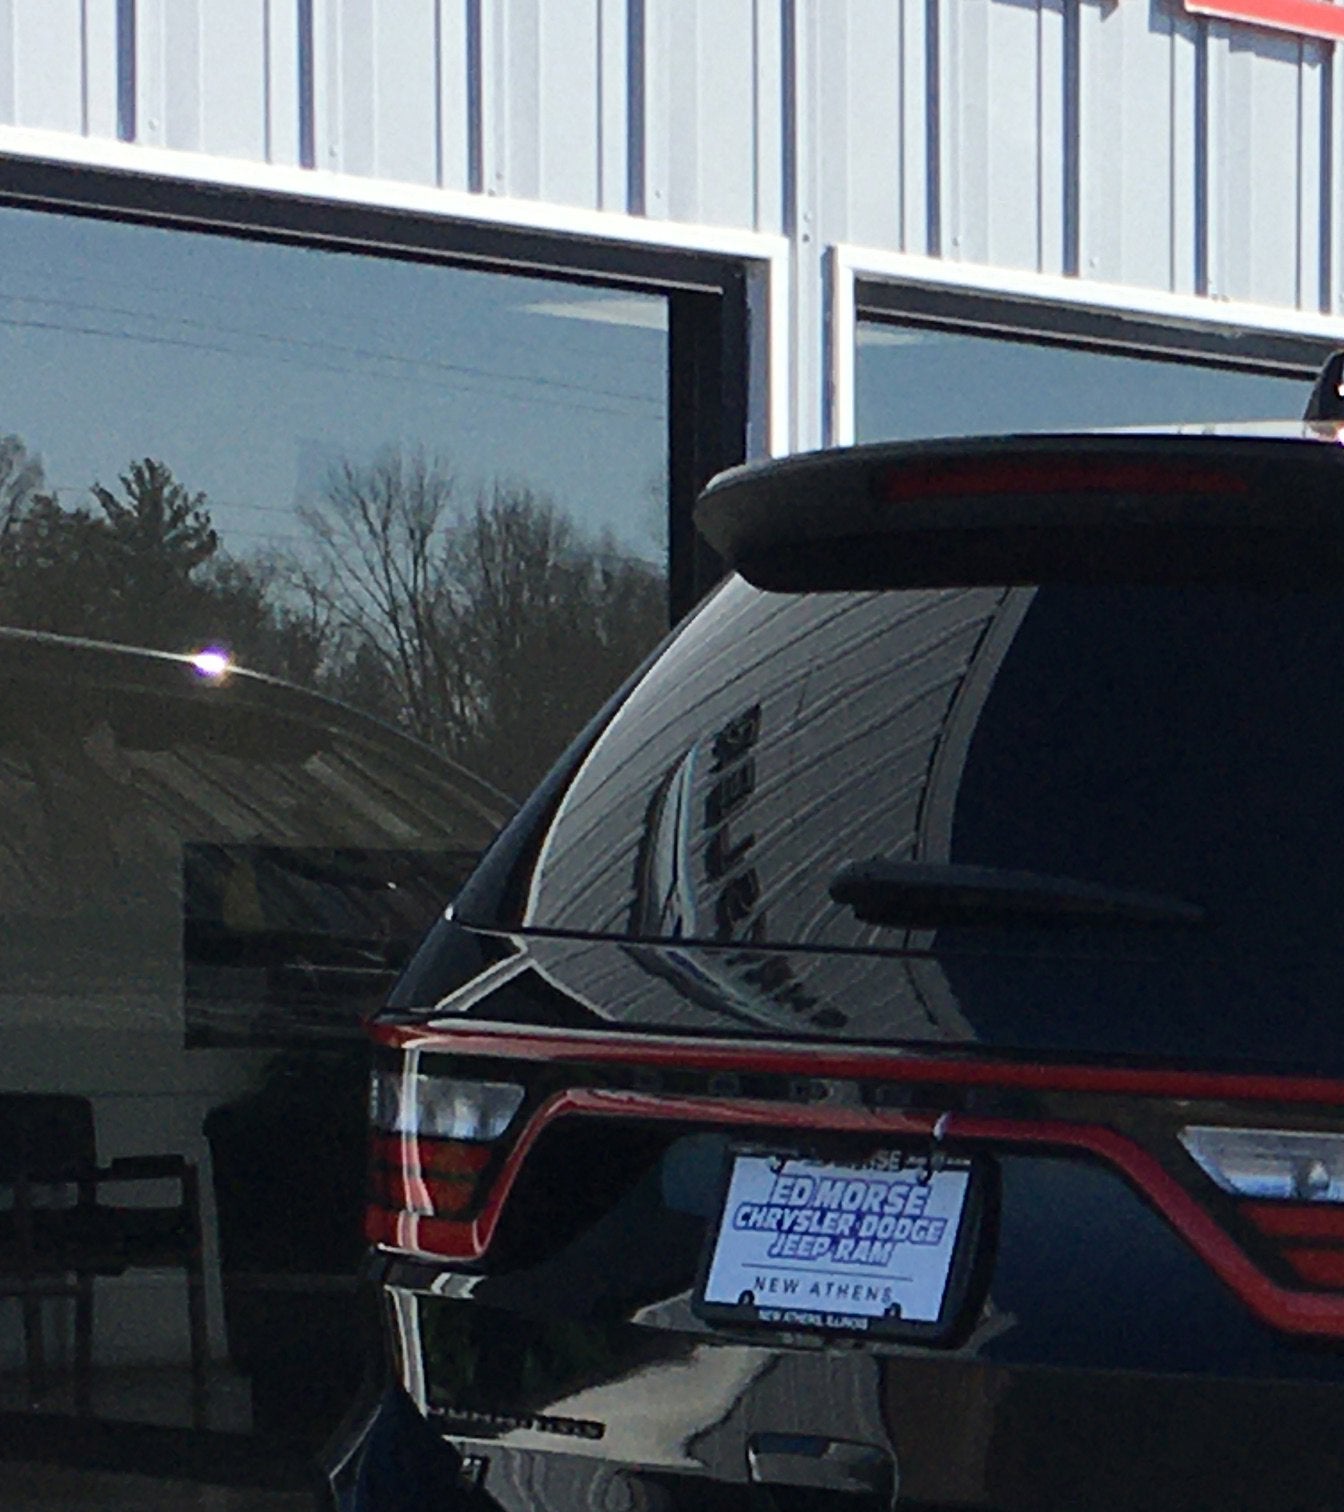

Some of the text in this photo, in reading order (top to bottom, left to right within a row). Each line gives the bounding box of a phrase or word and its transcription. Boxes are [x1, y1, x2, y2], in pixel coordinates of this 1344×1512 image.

[769, 1175, 930, 1215] ED MORSE
[735, 1204, 948, 1244] CHRYSLER DODGE
[769, 1233, 893, 1265] JEEP RAM
[755, 1275, 893, 1304] NEW ATHENS
